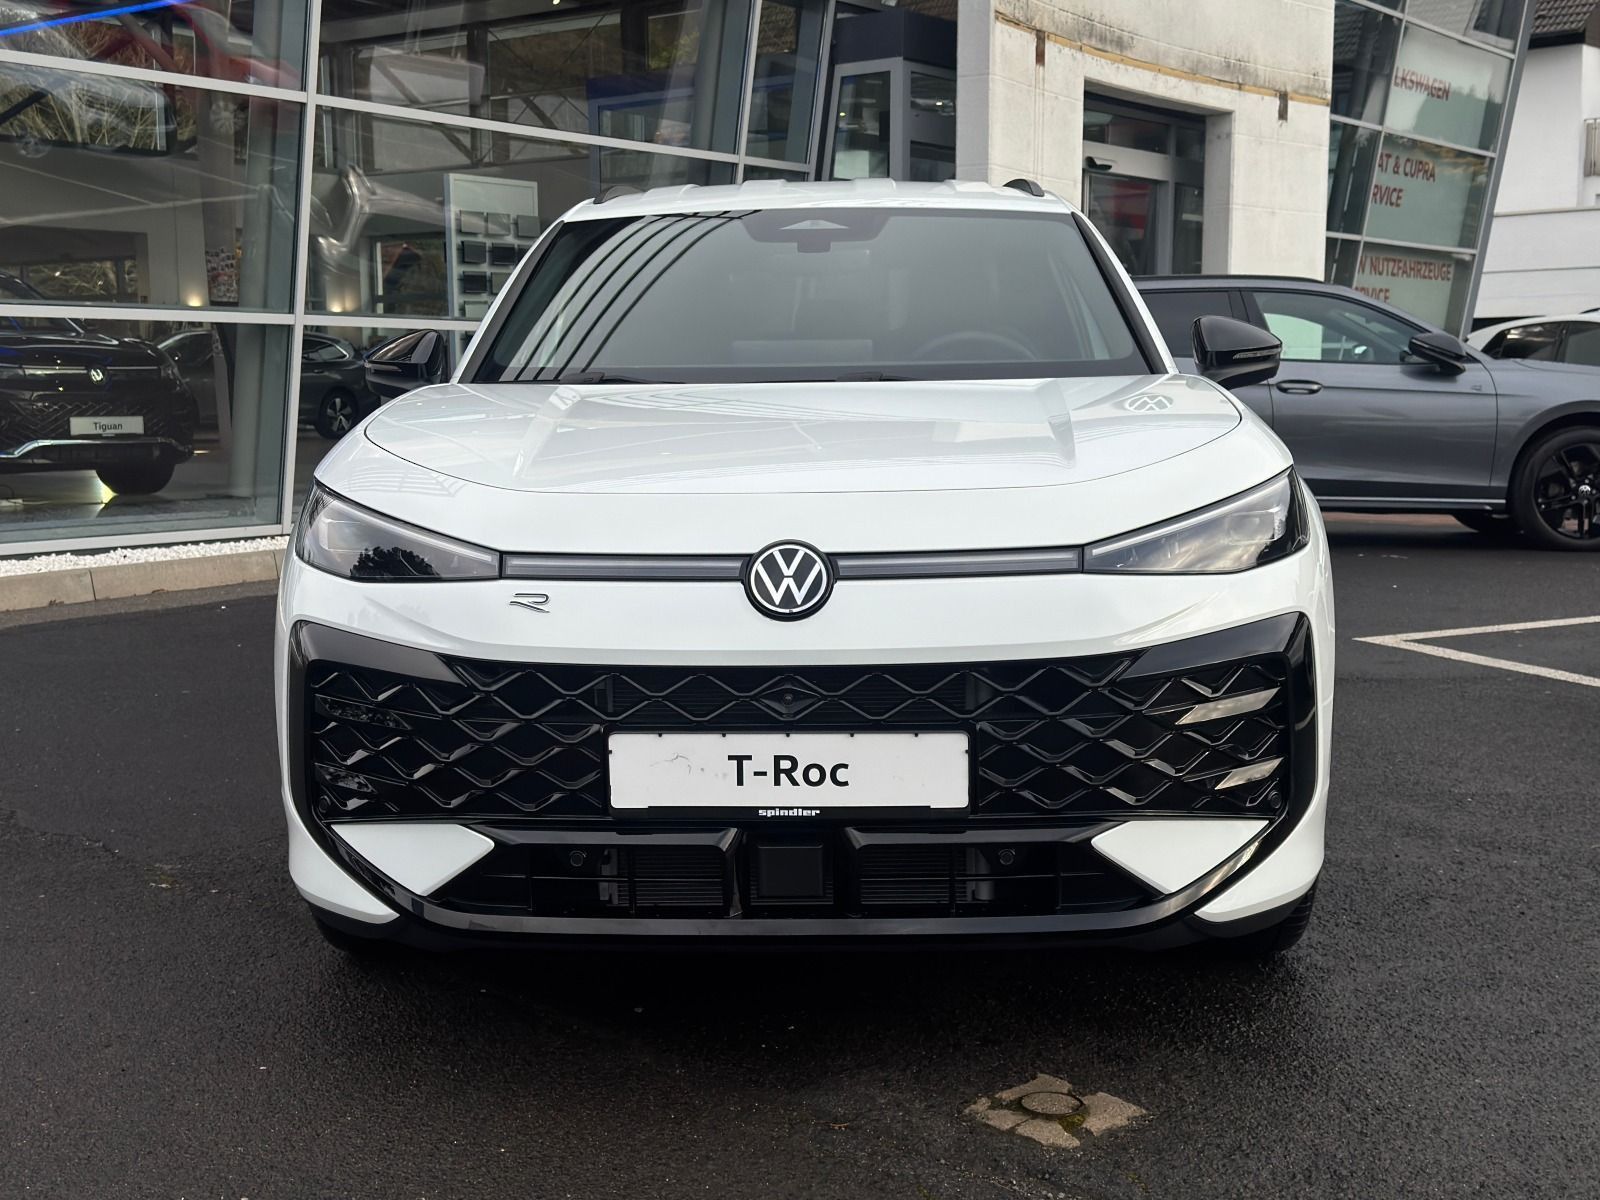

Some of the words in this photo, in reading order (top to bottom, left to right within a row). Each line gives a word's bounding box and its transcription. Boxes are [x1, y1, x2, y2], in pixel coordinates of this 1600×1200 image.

[1393, 156, 1401, 175] &
[1404, 158, 1436, 183] CUPRA
[1369, 257, 1452, 281] NUTZFAHRZEUGE
[93, 421, 123, 432] Tiguan
[728, 755, 849, 787] T-Roc
[758, 807, 820, 817] spindler
